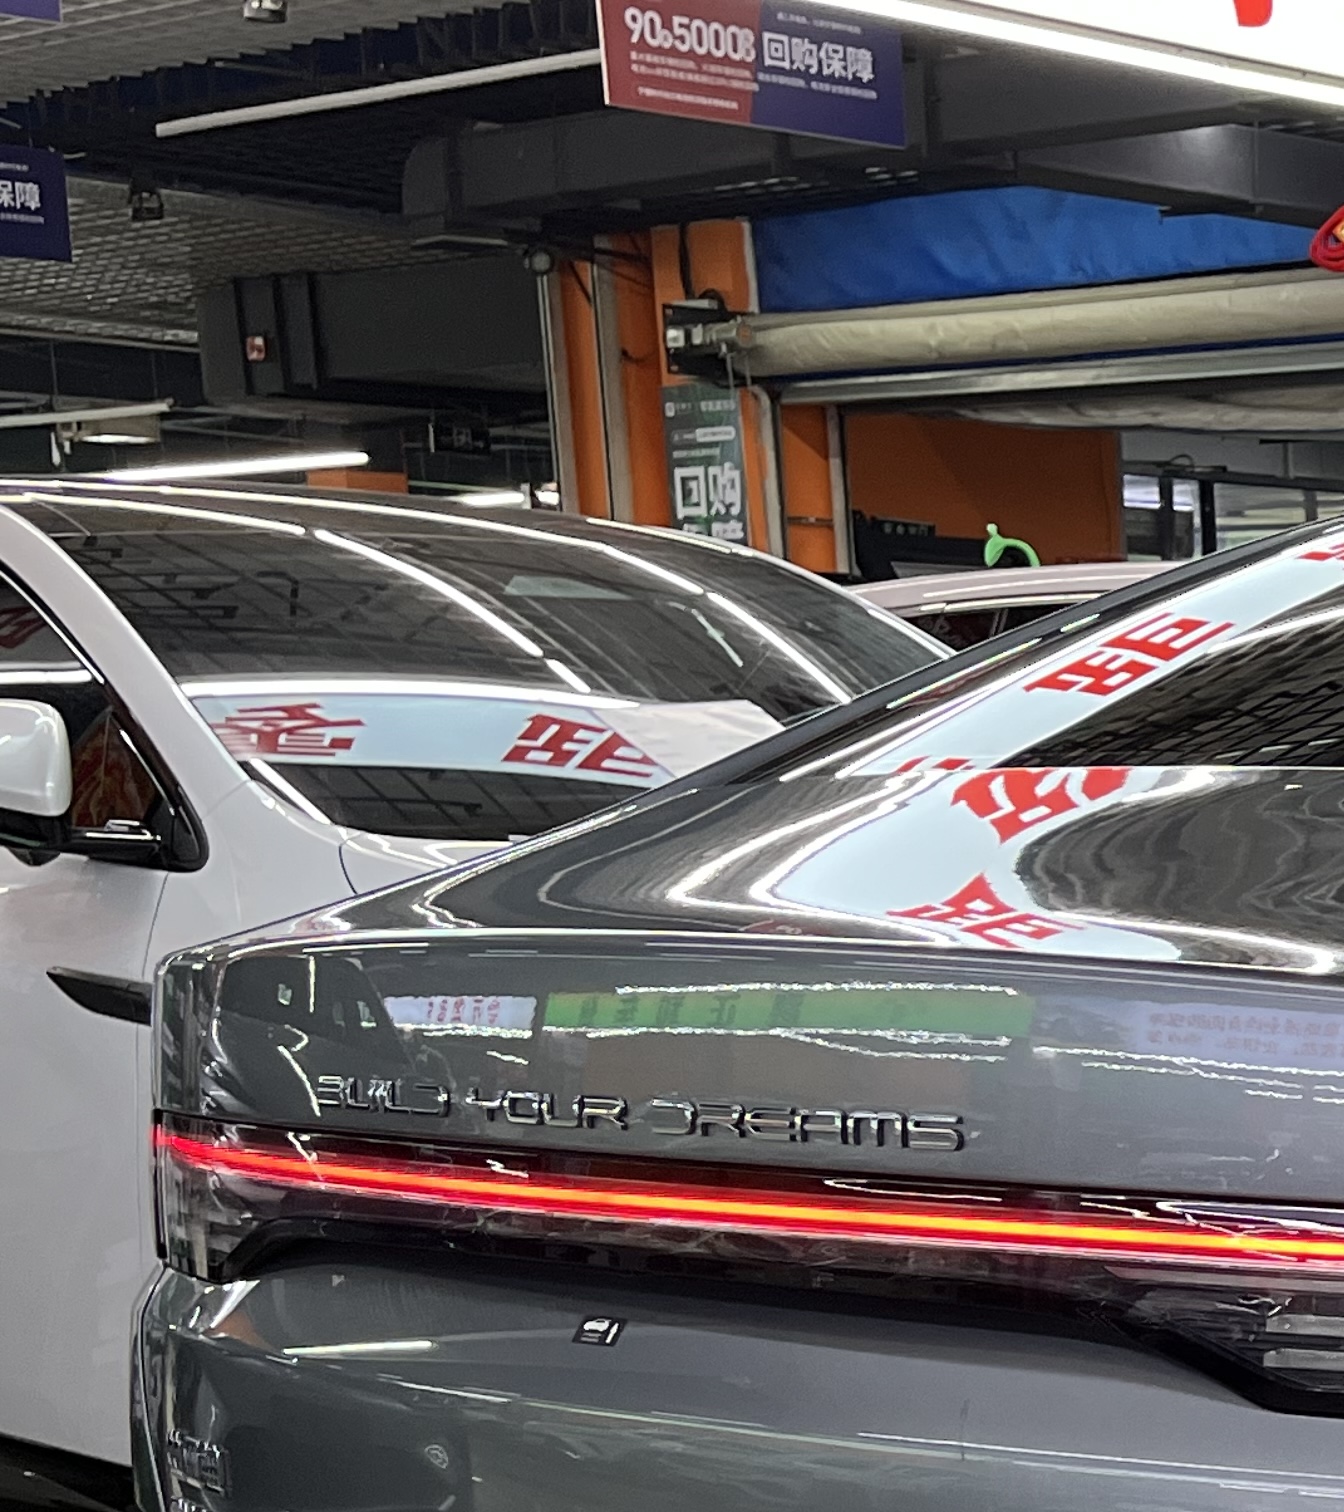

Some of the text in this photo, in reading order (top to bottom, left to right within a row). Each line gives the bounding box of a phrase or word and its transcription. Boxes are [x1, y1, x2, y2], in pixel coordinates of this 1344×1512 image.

[762, 31, 875, 83] 回购保障
[674, 462, 741, 519] 回购
[317, 1073, 965, 1152] BUILD YOUR DREAMS
